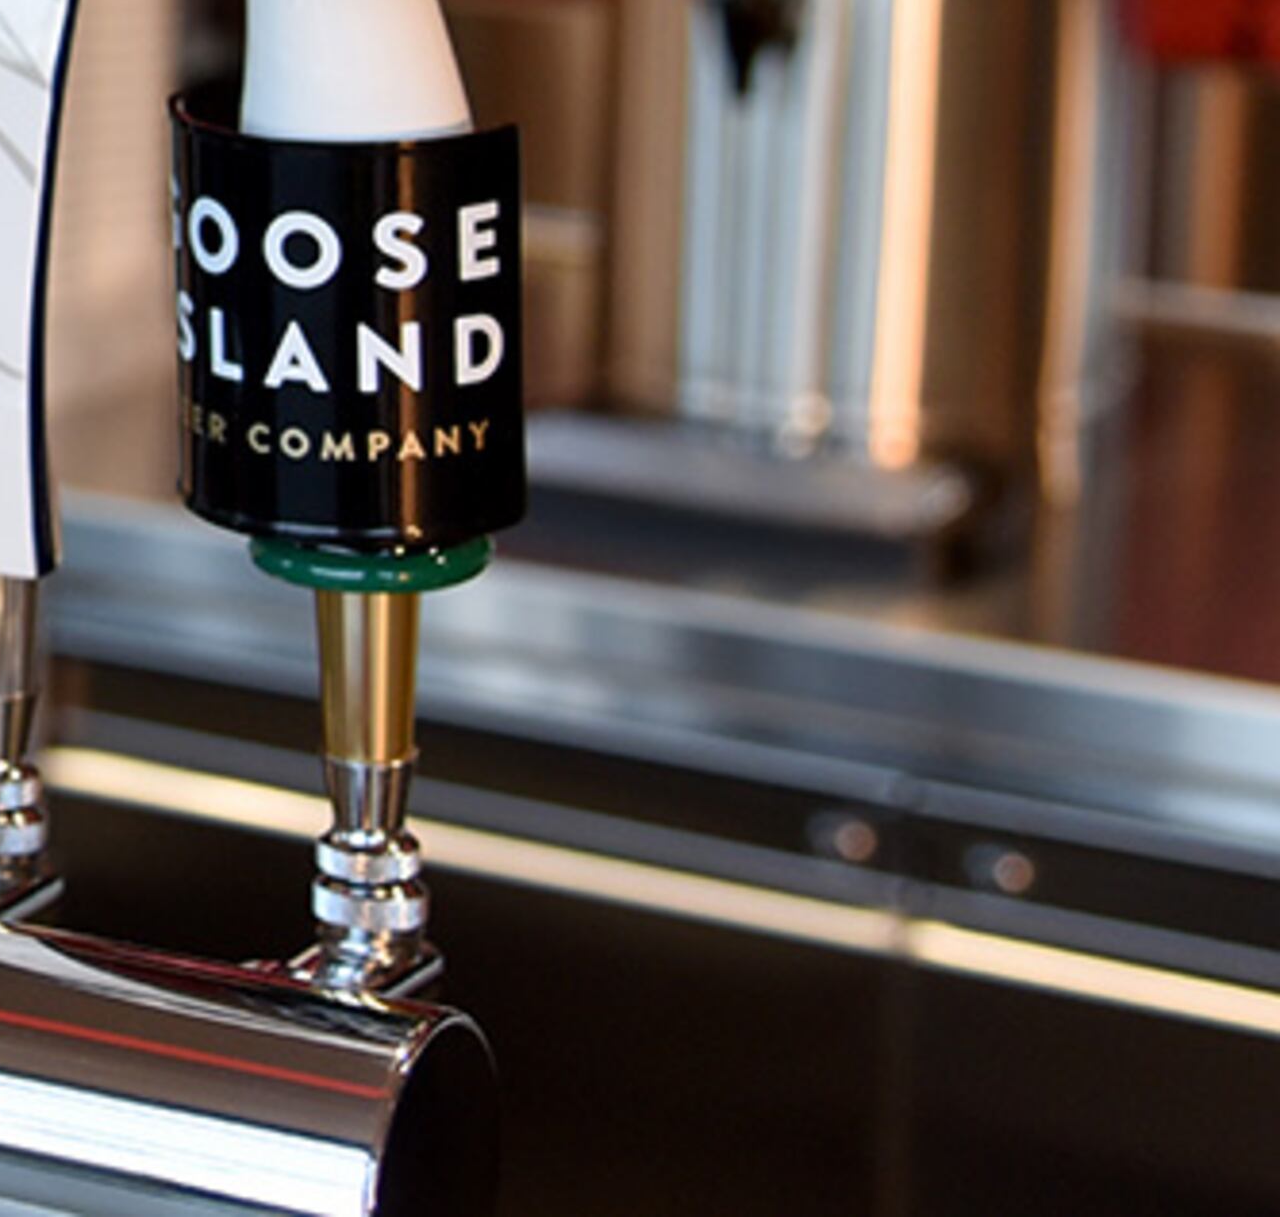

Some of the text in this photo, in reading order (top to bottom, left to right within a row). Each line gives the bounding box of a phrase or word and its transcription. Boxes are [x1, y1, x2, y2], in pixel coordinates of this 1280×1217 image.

[171, 173, 502, 290] OOSE
[177, 289, 506, 394] SLAND
[247, 419, 491, 463] COMPANY
